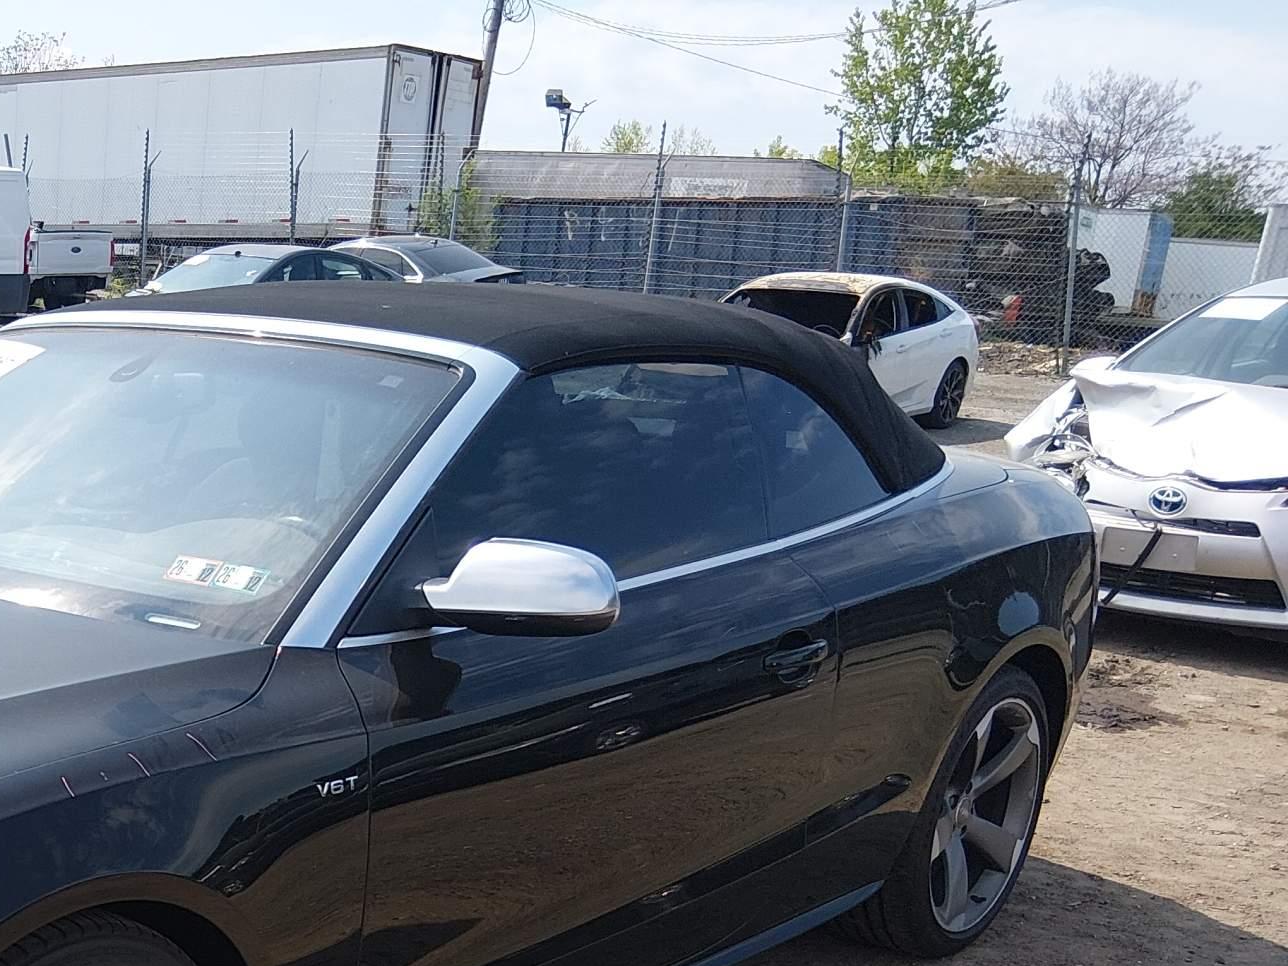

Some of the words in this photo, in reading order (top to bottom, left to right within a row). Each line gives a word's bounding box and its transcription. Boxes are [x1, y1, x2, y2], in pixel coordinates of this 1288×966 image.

[169, 559, 189, 576] 26
[197, 567, 215, 583] 12
[216, 566, 236, 584] 26
[243, 575, 262, 592] 12
[317, 775, 359, 798] V6T
